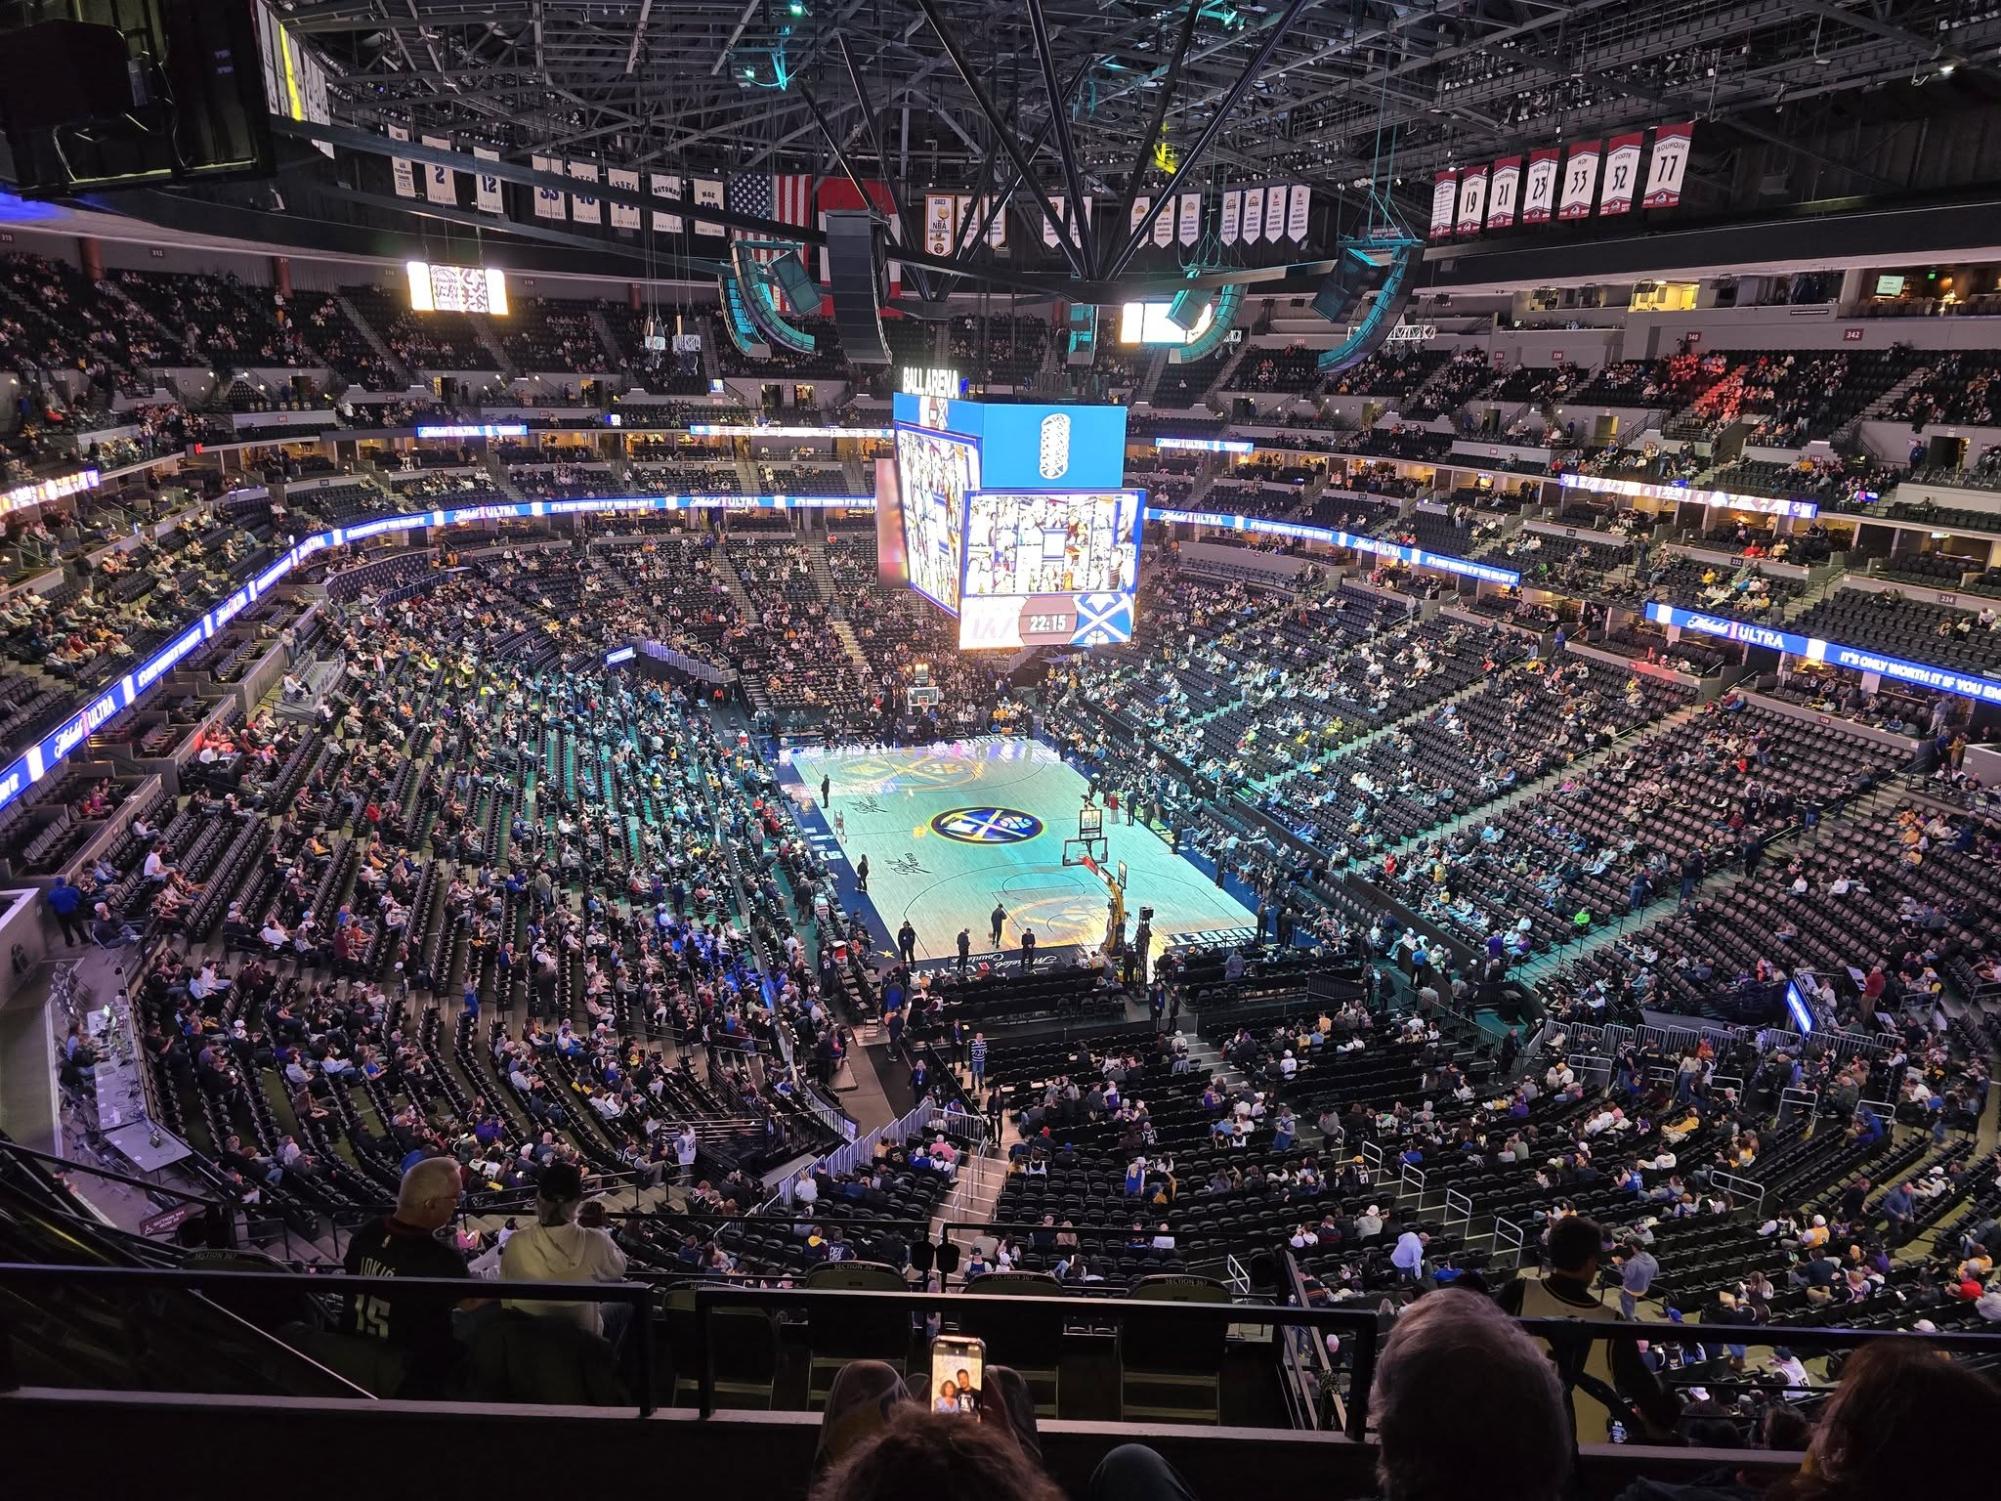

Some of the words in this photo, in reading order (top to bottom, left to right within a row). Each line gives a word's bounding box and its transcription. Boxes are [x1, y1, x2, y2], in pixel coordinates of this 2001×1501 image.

[434, 166, 445, 184] 2
[1612, 165, 1628, 191] 52
[1658, 155, 1678, 182] 77
[482, 175, 497, 193] 12
[1532, 177, 1546, 201] 23
[1571, 170, 1587, 195] 33
[1465, 192, 1477, 213] 19
[1497, 184, 1510, 207] 21
[932, 222, 947, 230] NBA
[902, 366, 925, 395] BALL
[925, 368, 959, 399] ARENA
[486, 505, 518, 517] ULTRA
[1030, 615, 1066, 631] 22:15
[1739, 626, 1784, 648] ULTRA
[1840, 651, 1859, 665] IT'S
[1859, 656, 1888, 671] ONLY
[1888, 663, 1930, 682] WORTH
[1931, 672, 1943, 685] IT
[1943, 675, 1956, 688] IF
[1957, 679, 1983, 695] YOU
[87, 695, 116, 729] ULTRA
[833, 1263, 863, 1271] SECTION
[1165, 1278, 1194, 1286] SECTION
[355, 1294, 391, 1339] 15
